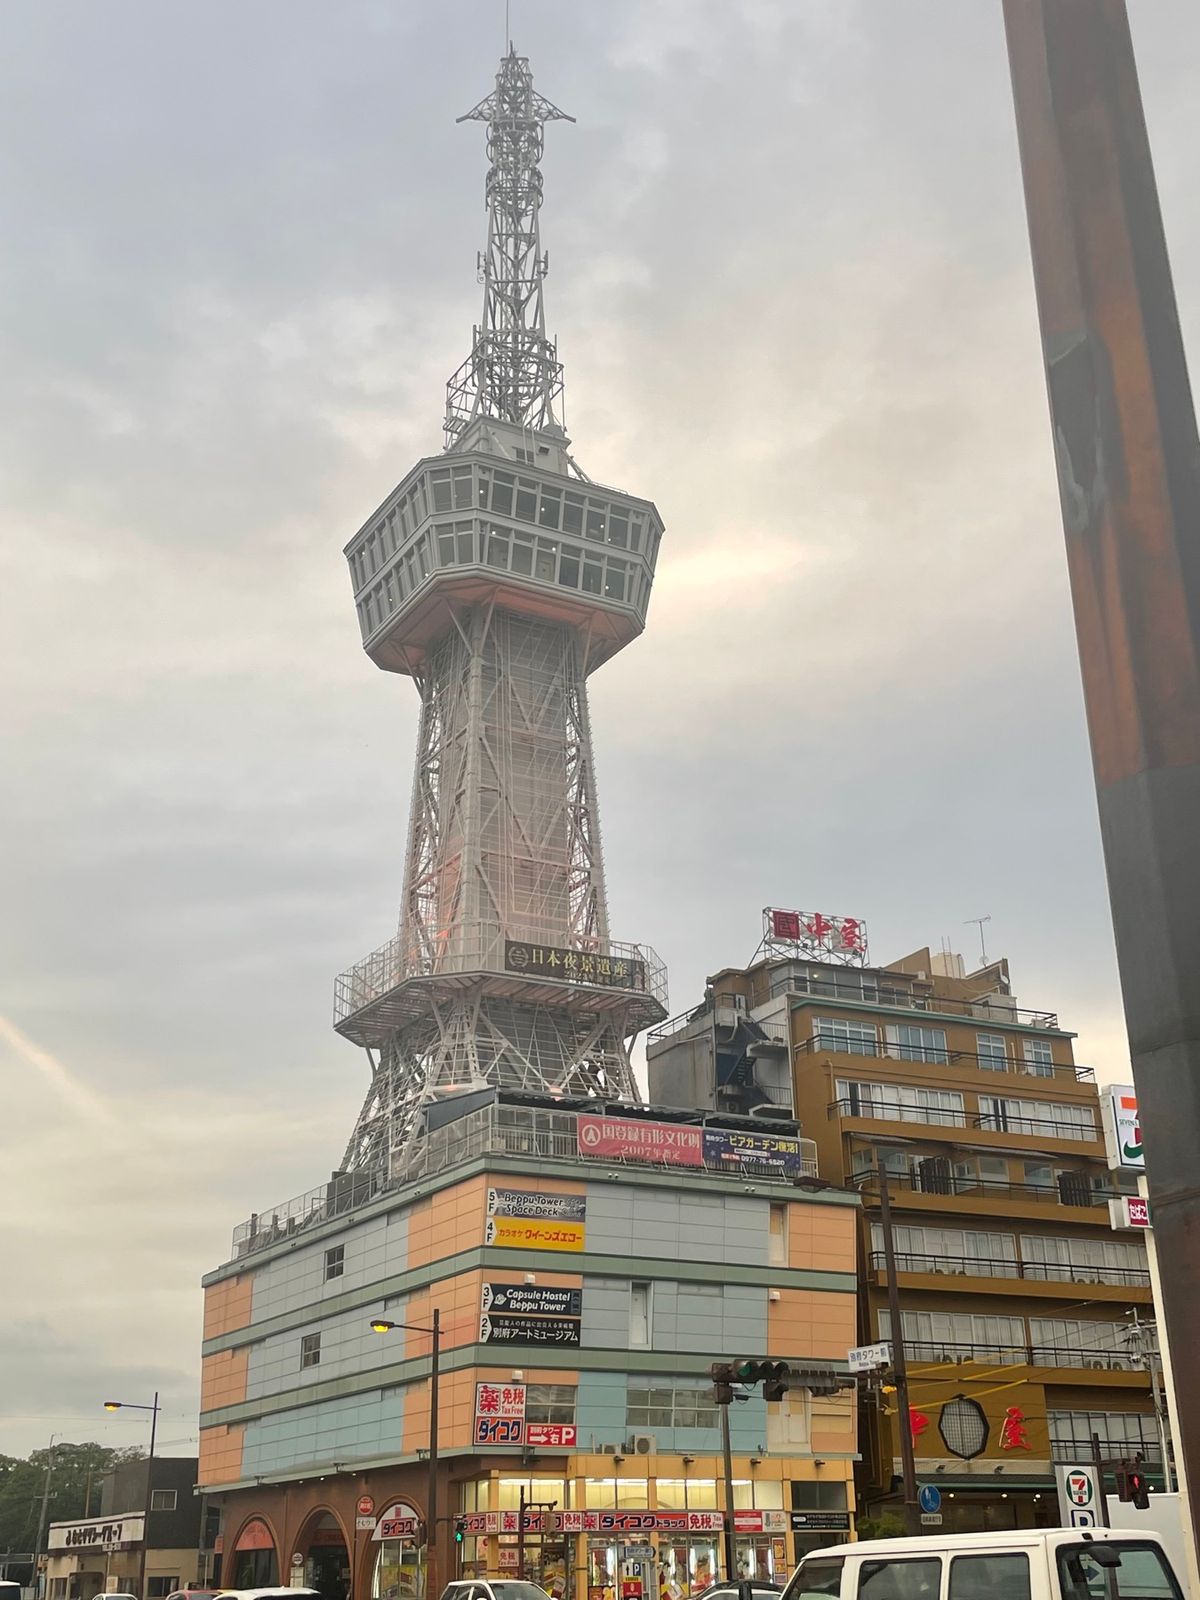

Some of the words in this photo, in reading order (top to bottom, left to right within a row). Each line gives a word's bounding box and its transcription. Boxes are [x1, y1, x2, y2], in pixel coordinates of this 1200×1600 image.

[532, 949, 628, 977] 日本夜景遺産
[504, 1193, 534, 1207] Beppu
[537, 1197, 563, 1206] Tower
[506, 1204, 533, 1215] Space
[535, 1206, 558, 1216] Deck
[499, 1229, 523, 1237] カラオケ
[525, 1230, 582, 1242] クイーンズエコー
[507, 1289, 541, 1300] Capsule
[542, 1291, 571, 1302] Hostel
[510, 1300, 538, 1311] Beppu
[539, 1301, 566, 1311] Tower
[493, 1328, 578, 1342] 別府アートミュージアム
[479, 1384, 499, 1413] 薬
[502, 1388, 524, 1404] 免税
[502, 1406, 511, 1414] Tax
[511, 1407, 523, 1415] Free
[479, 1419, 521, 1441] ダイコク
[562, 1427, 574, 1444] P
[550, 1434, 560, 1444] 右
[565, 1513, 581, 1525] 免税
[690, 1513, 711, 1529] 免税
[383, 1521, 412, 1535] ダイコク
[634, 1563, 640, 1575] P
